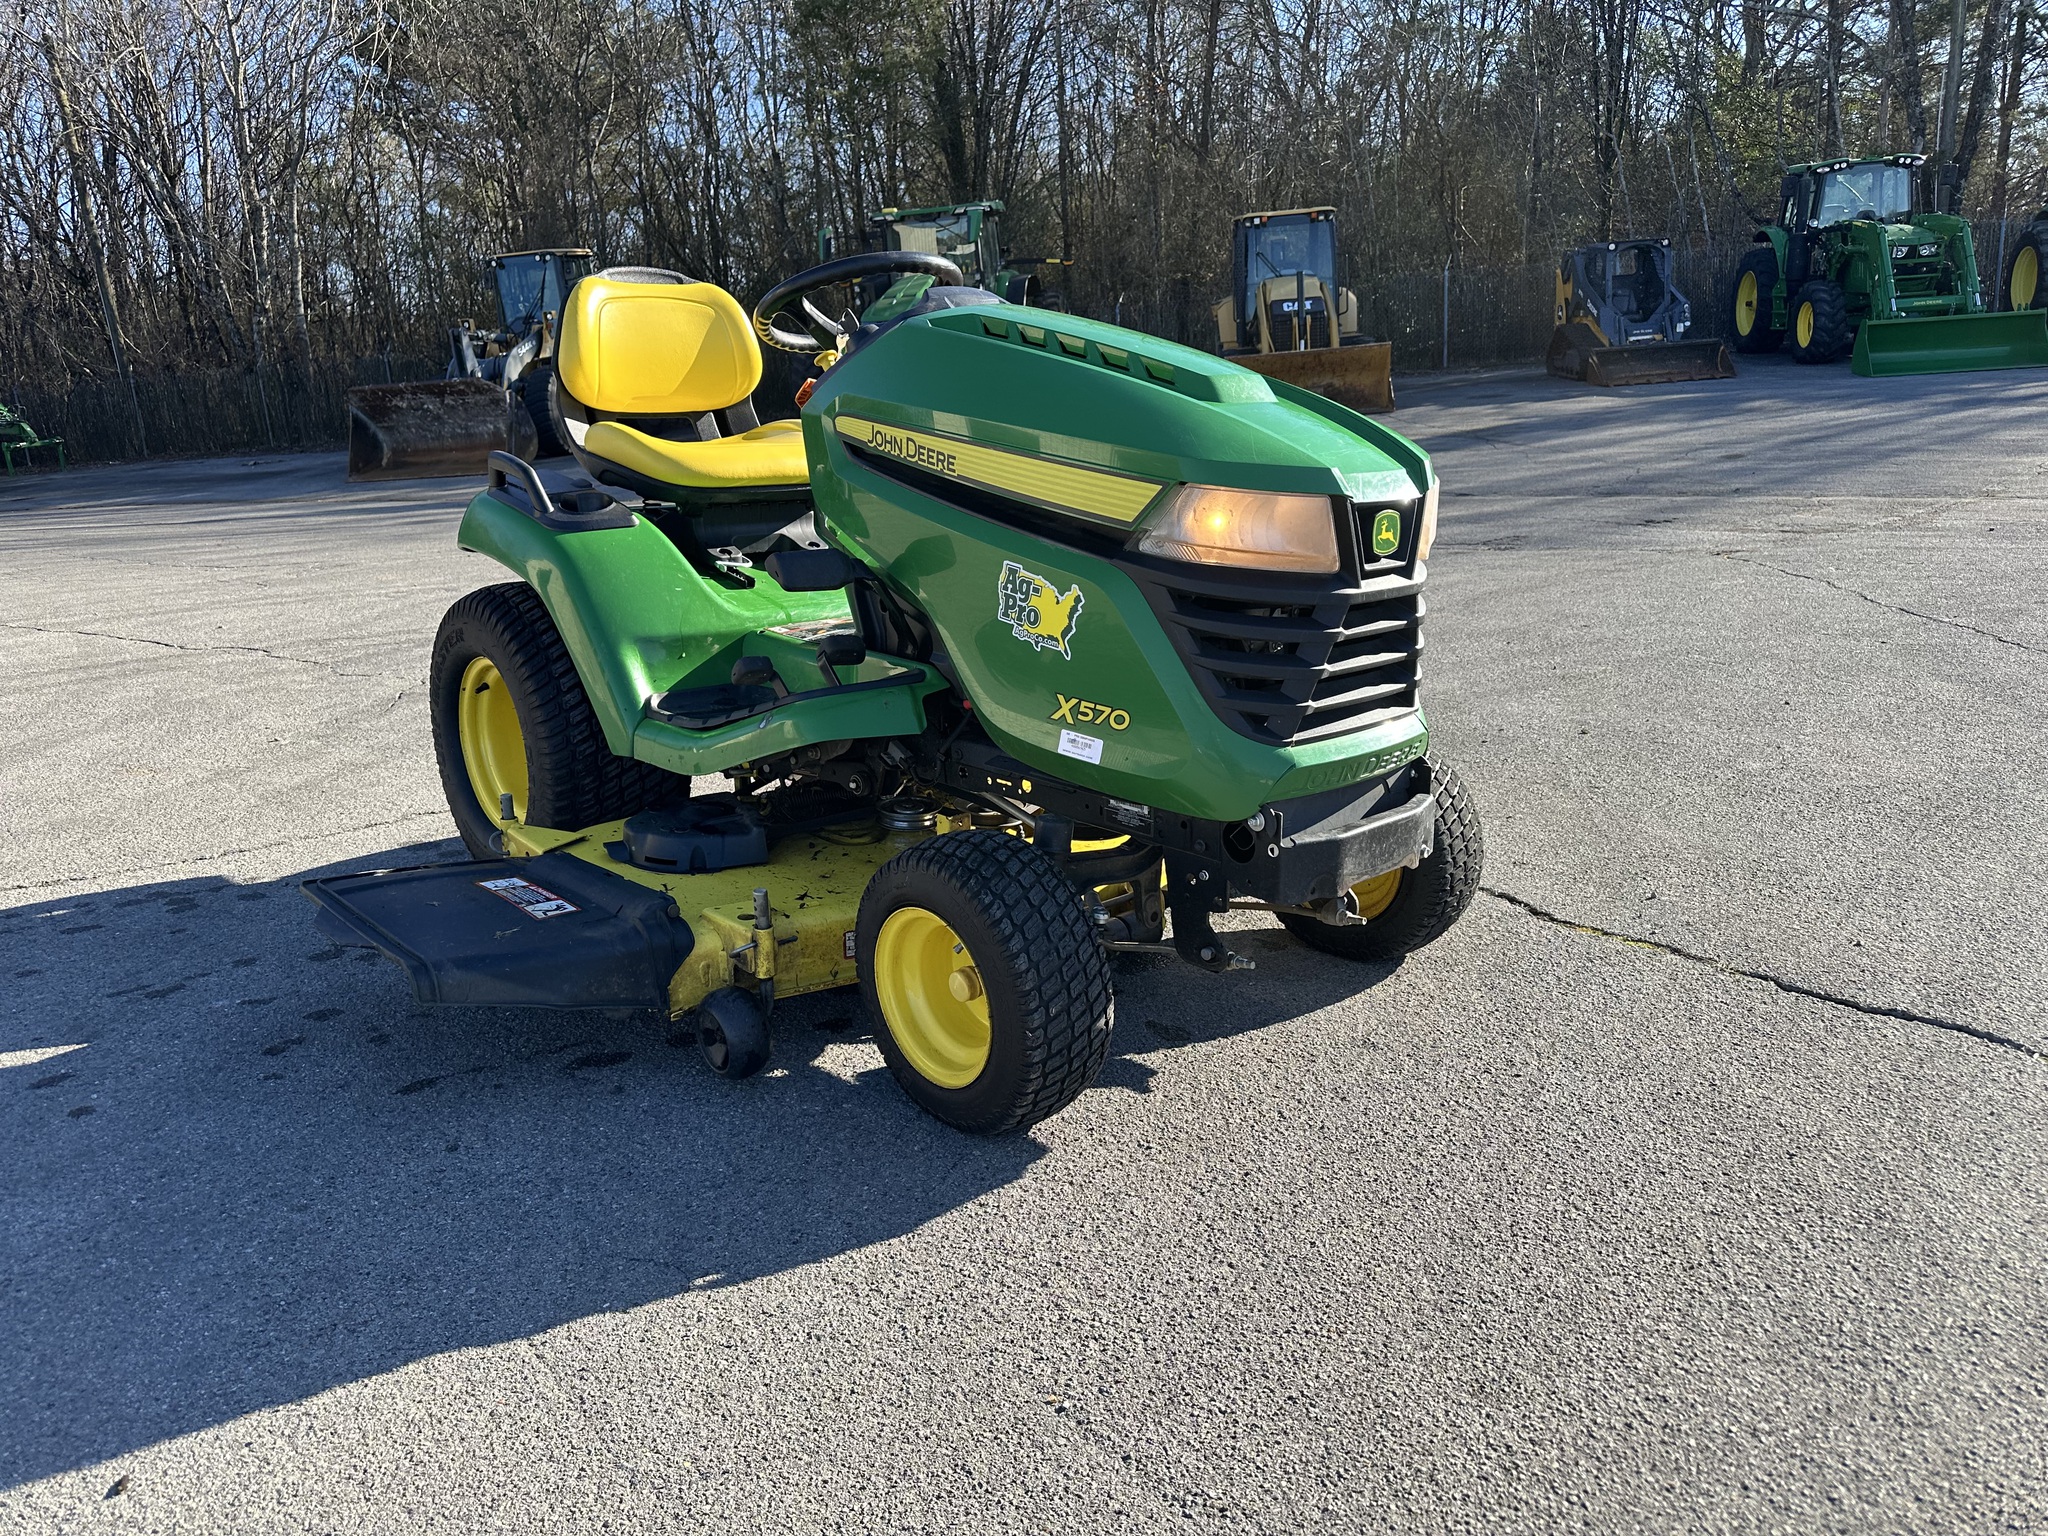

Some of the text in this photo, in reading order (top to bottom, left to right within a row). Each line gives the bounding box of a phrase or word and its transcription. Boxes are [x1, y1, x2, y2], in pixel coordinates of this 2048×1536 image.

[1282, 300, 1313, 312] CAT
[867, 424, 957, 474] JOHN DEERE
[1002, 565, 1041, 604] Ag-
[1001, 592, 1041, 628] Pro
[1014, 626, 1060, 648] AgProCo.com
[1049, 692, 1131, 731] X570
[1306, 739, 1422, 790] JOHN DEERE
